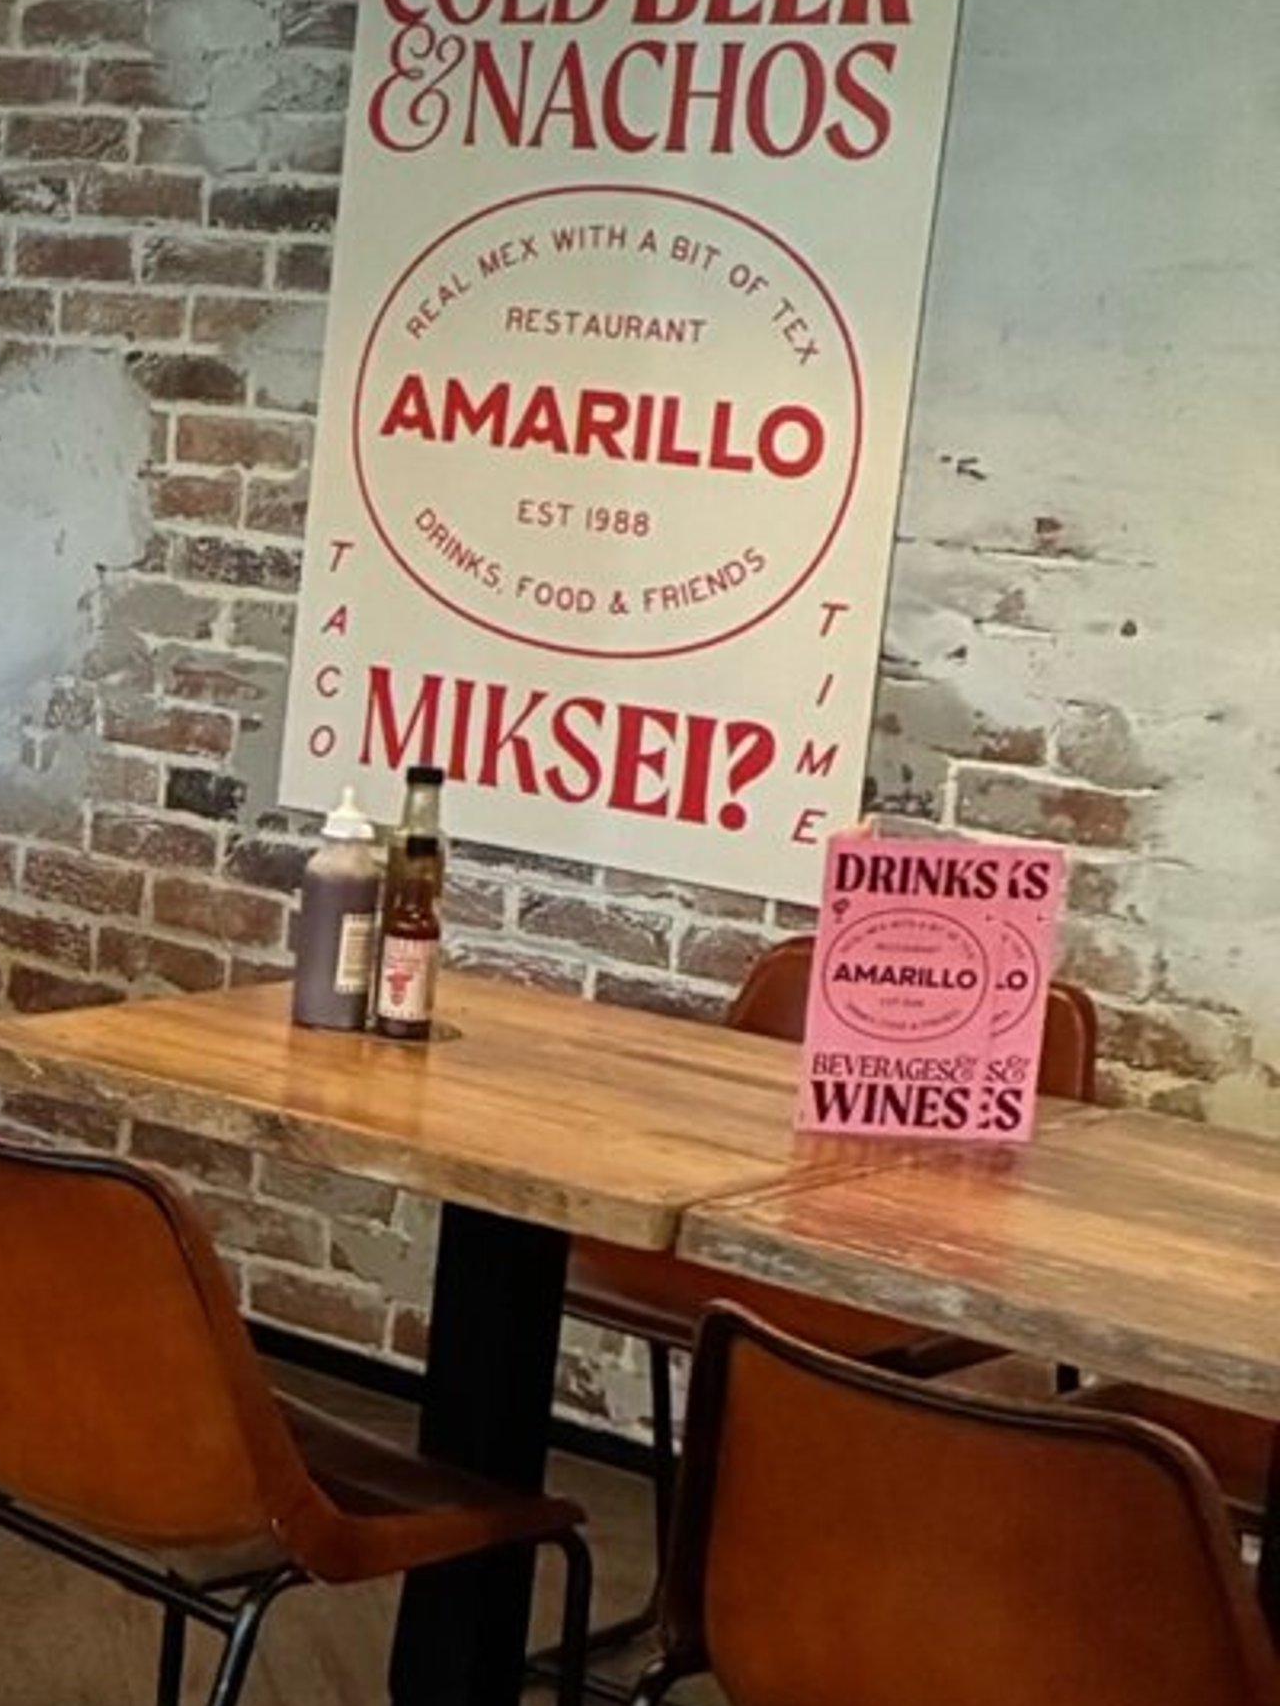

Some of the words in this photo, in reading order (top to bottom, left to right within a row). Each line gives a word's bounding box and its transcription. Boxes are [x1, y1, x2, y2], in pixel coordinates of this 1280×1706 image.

[406, 271, 471, 340] REAL
[478, 234, 539, 279] MEX
[551, 225, 627, 254] WITH
[638, 229, 658, 253] A
[670, 235, 722, 270] BIT
[729, 263, 770, 297] OF
[770, 296, 821, 365] TEX
[505, 306, 709, 345] RESTAURANT
[379, 373, 826, 479] AMARILLO
[516, 499, 574, 528] EST
[585, 505, 652, 538] 1988
[515, 575, 597, 612] FOOD
[608, 590, 630, 615] &
[643, 547, 768, 612] FRIENDS
[357, 663, 777, 832] MIKSEI?
[835, 853, 999, 900] DRINKS
[832, 961, 978, 989] AMARILLO
[810, 1080, 971, 1129] WINES
